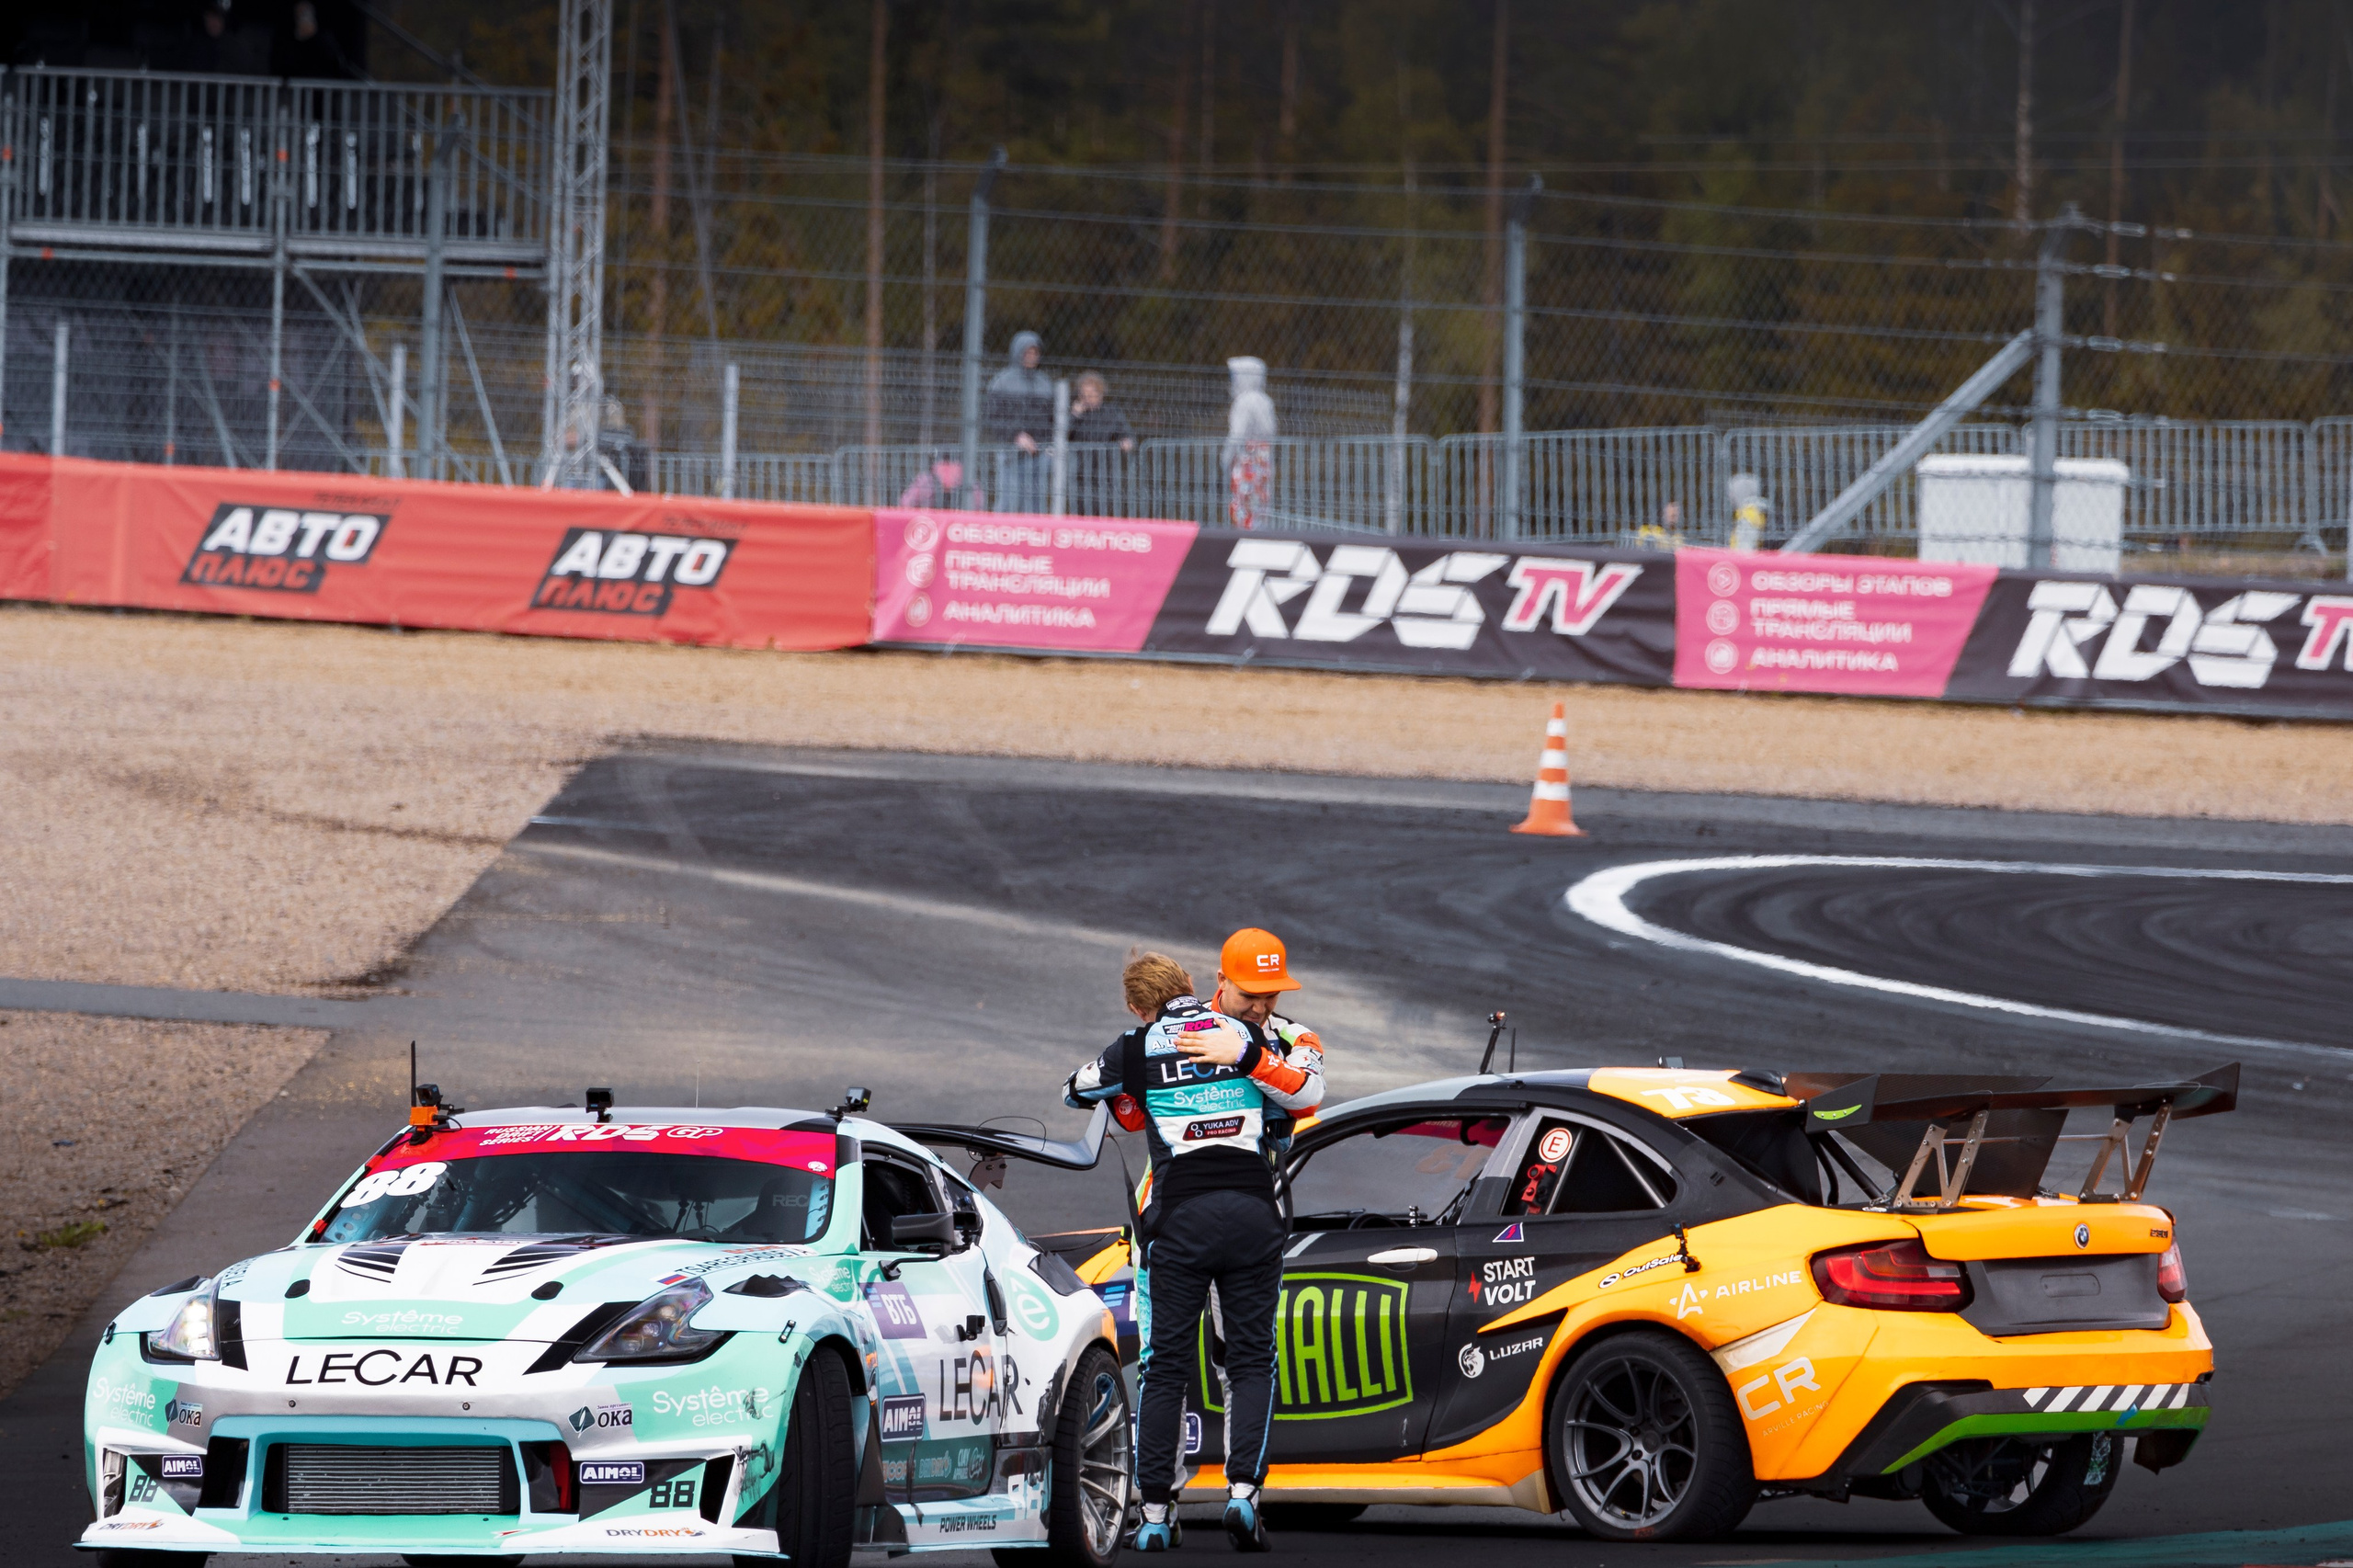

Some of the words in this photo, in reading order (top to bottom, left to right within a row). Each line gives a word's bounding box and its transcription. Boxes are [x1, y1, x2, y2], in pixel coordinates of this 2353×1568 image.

[202, 506, 381, 562] АВТО
[947, 523, 1051, 548] ОБЗОРЫ
[1053, 528, 1153, 553] ЭТАПОВ
[551, 530, 727, 585] АВТО
[945, 551, 1053, 574] ПРЯМЫЕ
[188, 553, 315, 588] ПЛЮС
[538, 576, 665, 612] ПЛЮС
[945, 570, 1111, 599] ТРАНСЛЯЦИИ
[1205, 538, 1512, 651] RDS
[1501, 555, 1644, 636] TV
[1751, 570, 1855, 594] ОБЗОРЫ
[1857, 574, 1953, 597] ЭТАПОВ
[943, 600, 1097, 630] АНАЛИТИКА
[1750, 597, 1856, 621] ПРЯМЫЕ
[1751, 618, 1913, 644] ТРАНСЛЯЦИИ
[2007, 579, 2302, 689] RDS
[1751, 647, 1899, 672] АНАЛИТИКА
[1256, 954, 1280, 967] CR
[1184, 1018, 1213, 1032] RDS
[1199, 1098, 1245, 1113] electric
[1640, 1085, 1736, 1110] 73
[483, 1124, 551, 1135] RUSSIAN
[496, 1131, 546, 1140] DRIFT
[545, 1124, 676, 1142] RDS
[666, 1126, 723, 1139] GP
[1202, 1121, 1224, 1130] YUKA
[1224, 1119, 1240, 1128] ADV
[479, 1135, 536, 1146] SERIES
[1548, 1136, 1563, 1153] E
[340, 1162, 448, 1209] 88
[1483, 1256, 1535, 1283] START
[1622, 1254, 1684, 1278] OutSale
[1484, 1279, 1536, 1306] VOLT
[1715, 1271, 1802, 1300] AIRLINE
[881, 1293, 917, 1325] ВТБ
[375, 1322, 459, 1335] electric
[1489, 1336, 1543, 1361] LUZAR
[285, 1349, 483, 1387] LECAR
[938, 1349, 1024, 1426] LECAR
[1737, 1356, 1821, 1421] CR
[109, 1403, 153, 1427] electric
[883, 1406, 924, 1434] AIMOL
[1796, 1400, 1830, 1420] RACING
[164, 1459, 200, 1473] AIMOL
[583, 1466, 642, 1480] AIMOL
[128, 1474, 159, 1503] 88
[649, 1480, 696, 1508] 88
[99, 1522, 149, 1531] DRYDRY
[607, 1528, 681, 1538] DRYDRY
[939, 1516, 966, 1533] POWER
[966, 1514, 997, 1530] WHEELS
